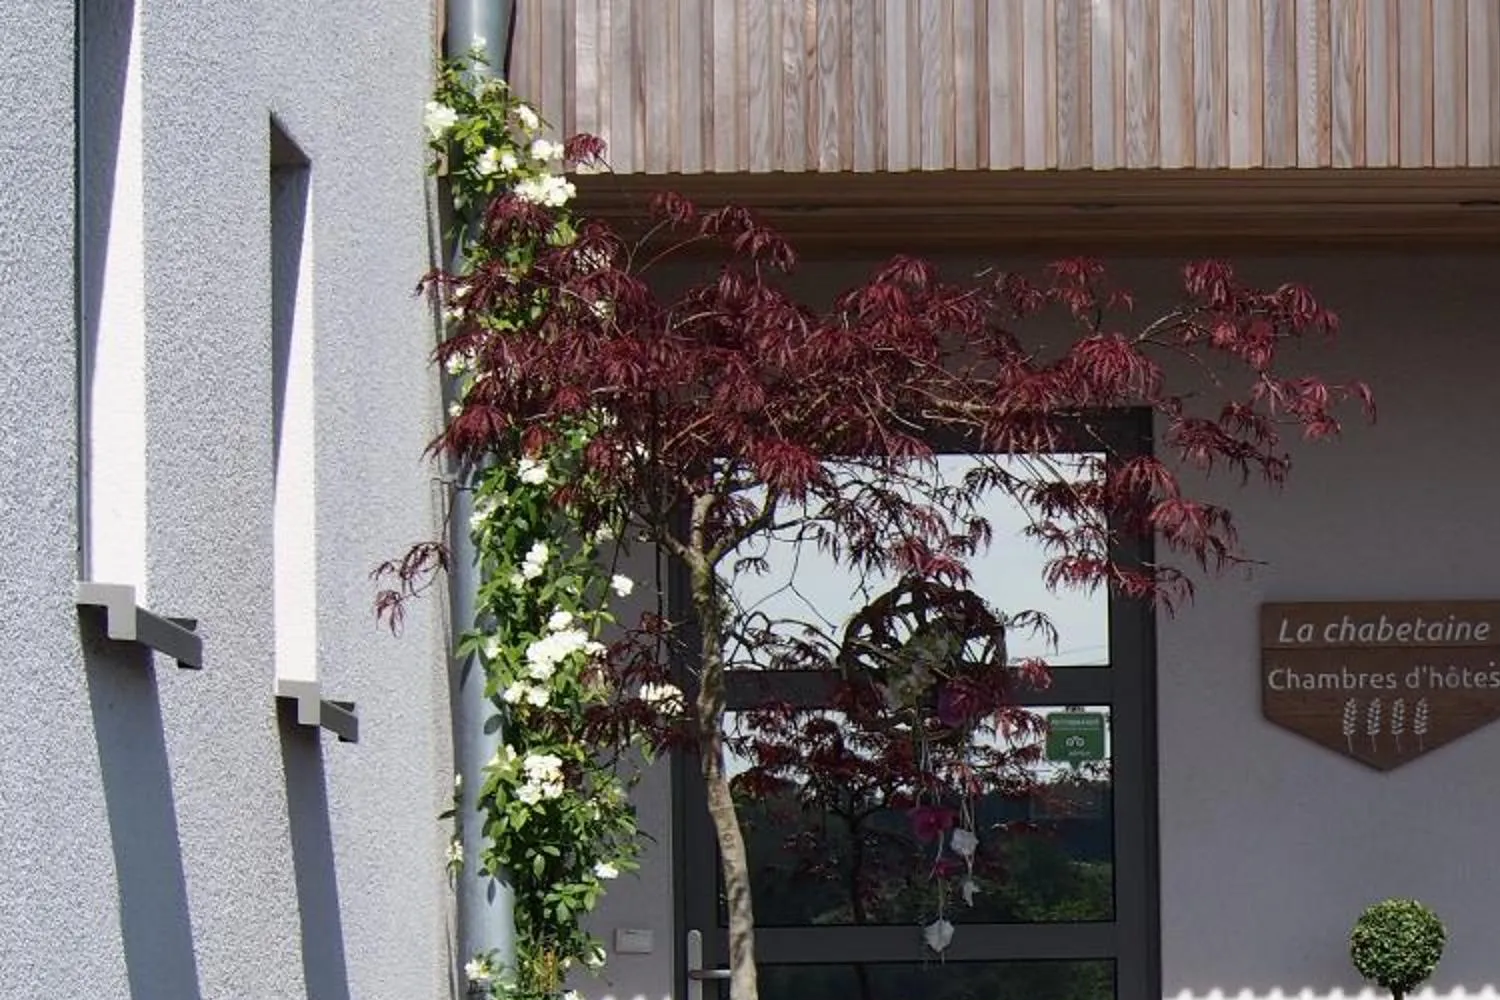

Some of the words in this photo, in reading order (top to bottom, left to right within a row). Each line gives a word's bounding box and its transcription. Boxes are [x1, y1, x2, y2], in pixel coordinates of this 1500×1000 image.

[1279, 618, 1313, 643] La
[1323, 614, 1490, 642] chabetaine
[1268, 666, 1397, 690] Chambres
